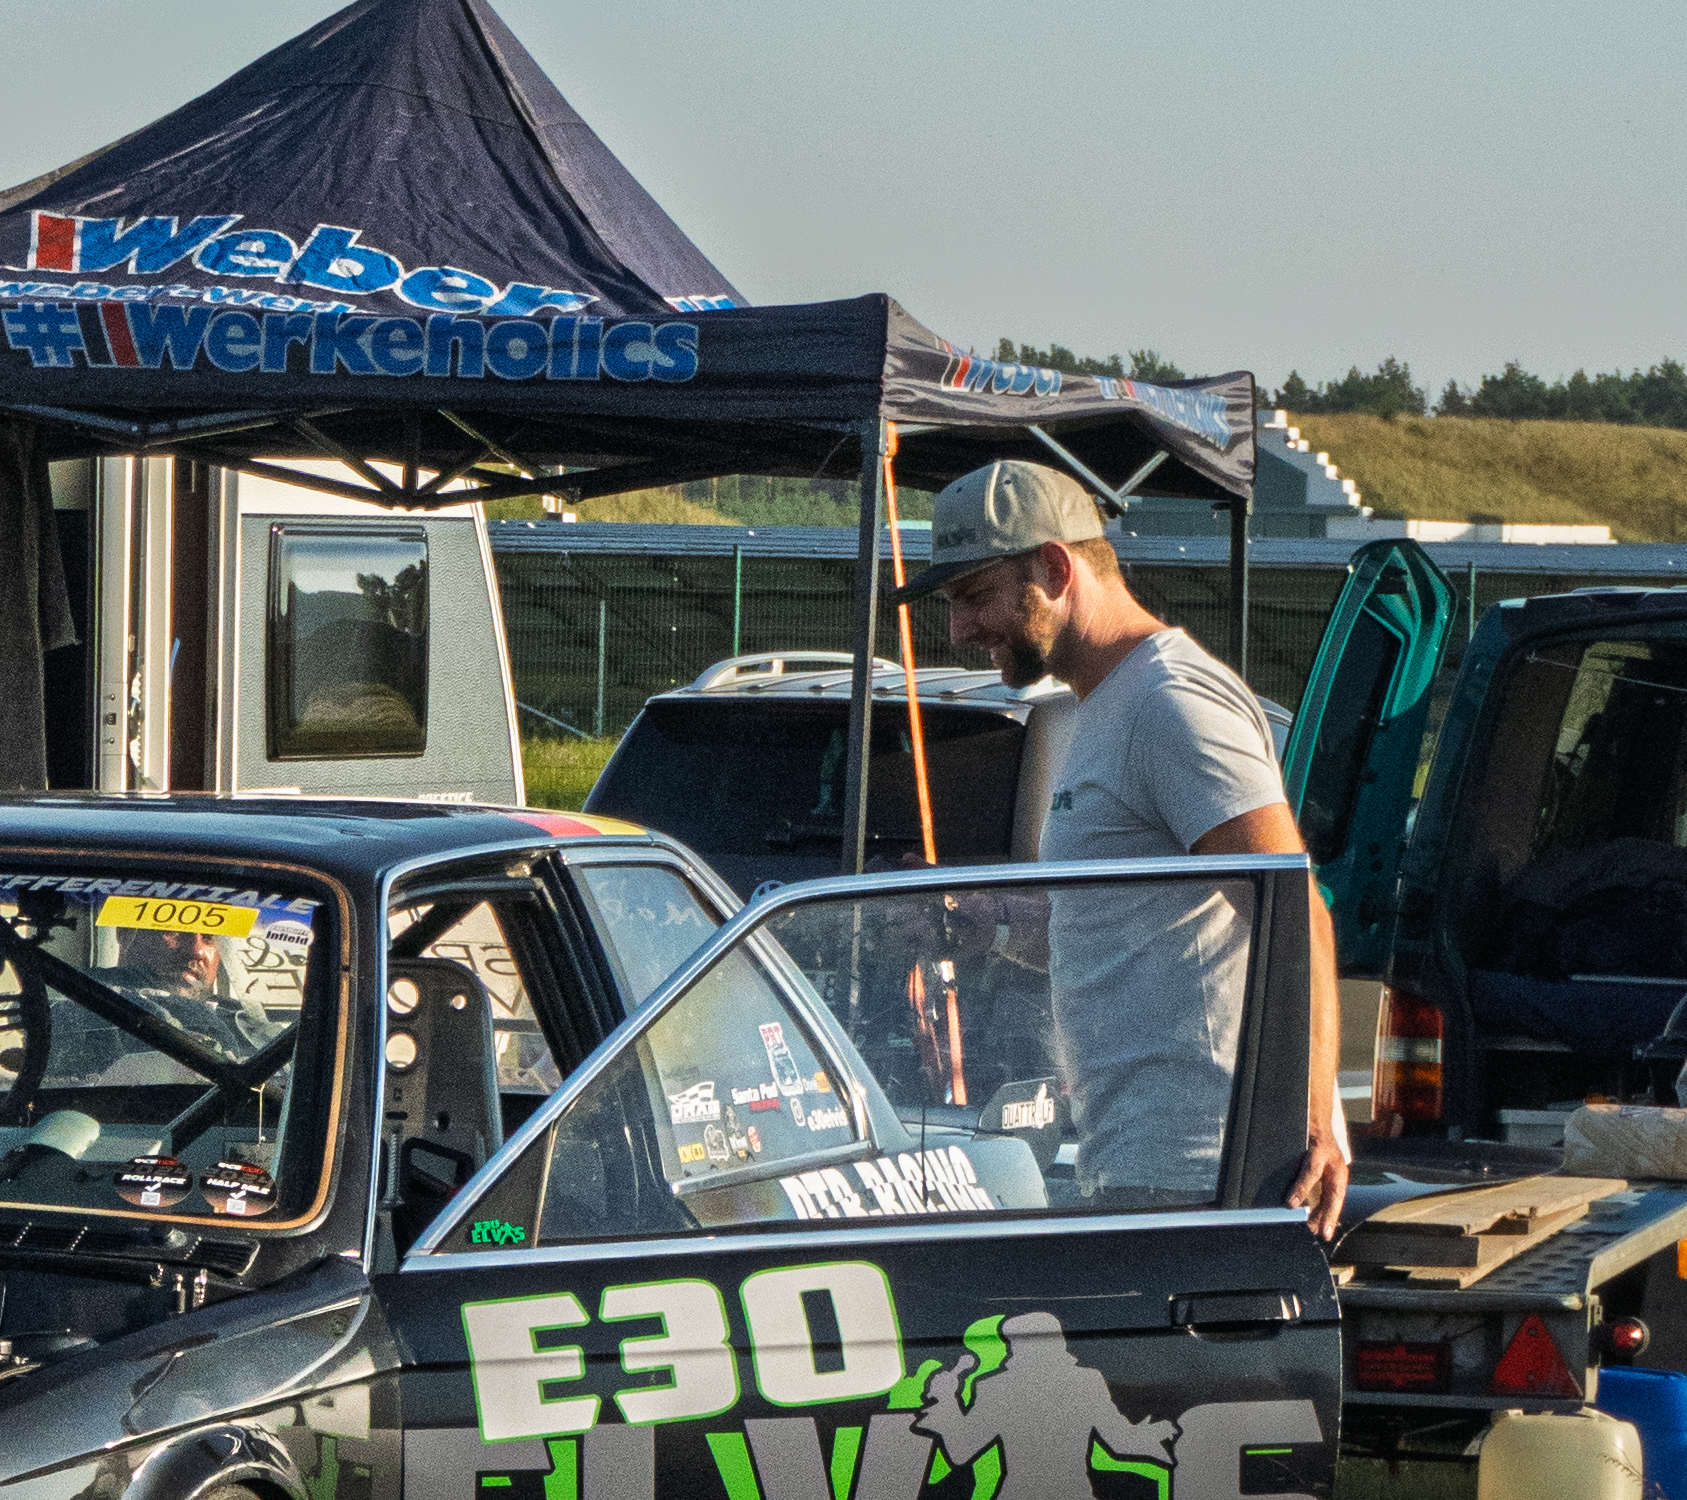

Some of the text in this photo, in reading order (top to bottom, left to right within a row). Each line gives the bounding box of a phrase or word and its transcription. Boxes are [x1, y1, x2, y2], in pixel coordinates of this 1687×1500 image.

[76, 213, 600, 316] Weber
[133, 900, 229, 928] 1005
[121, 1173, 187, 1186] ROLLRACE
[461, 1259, 908, 1443] E30
